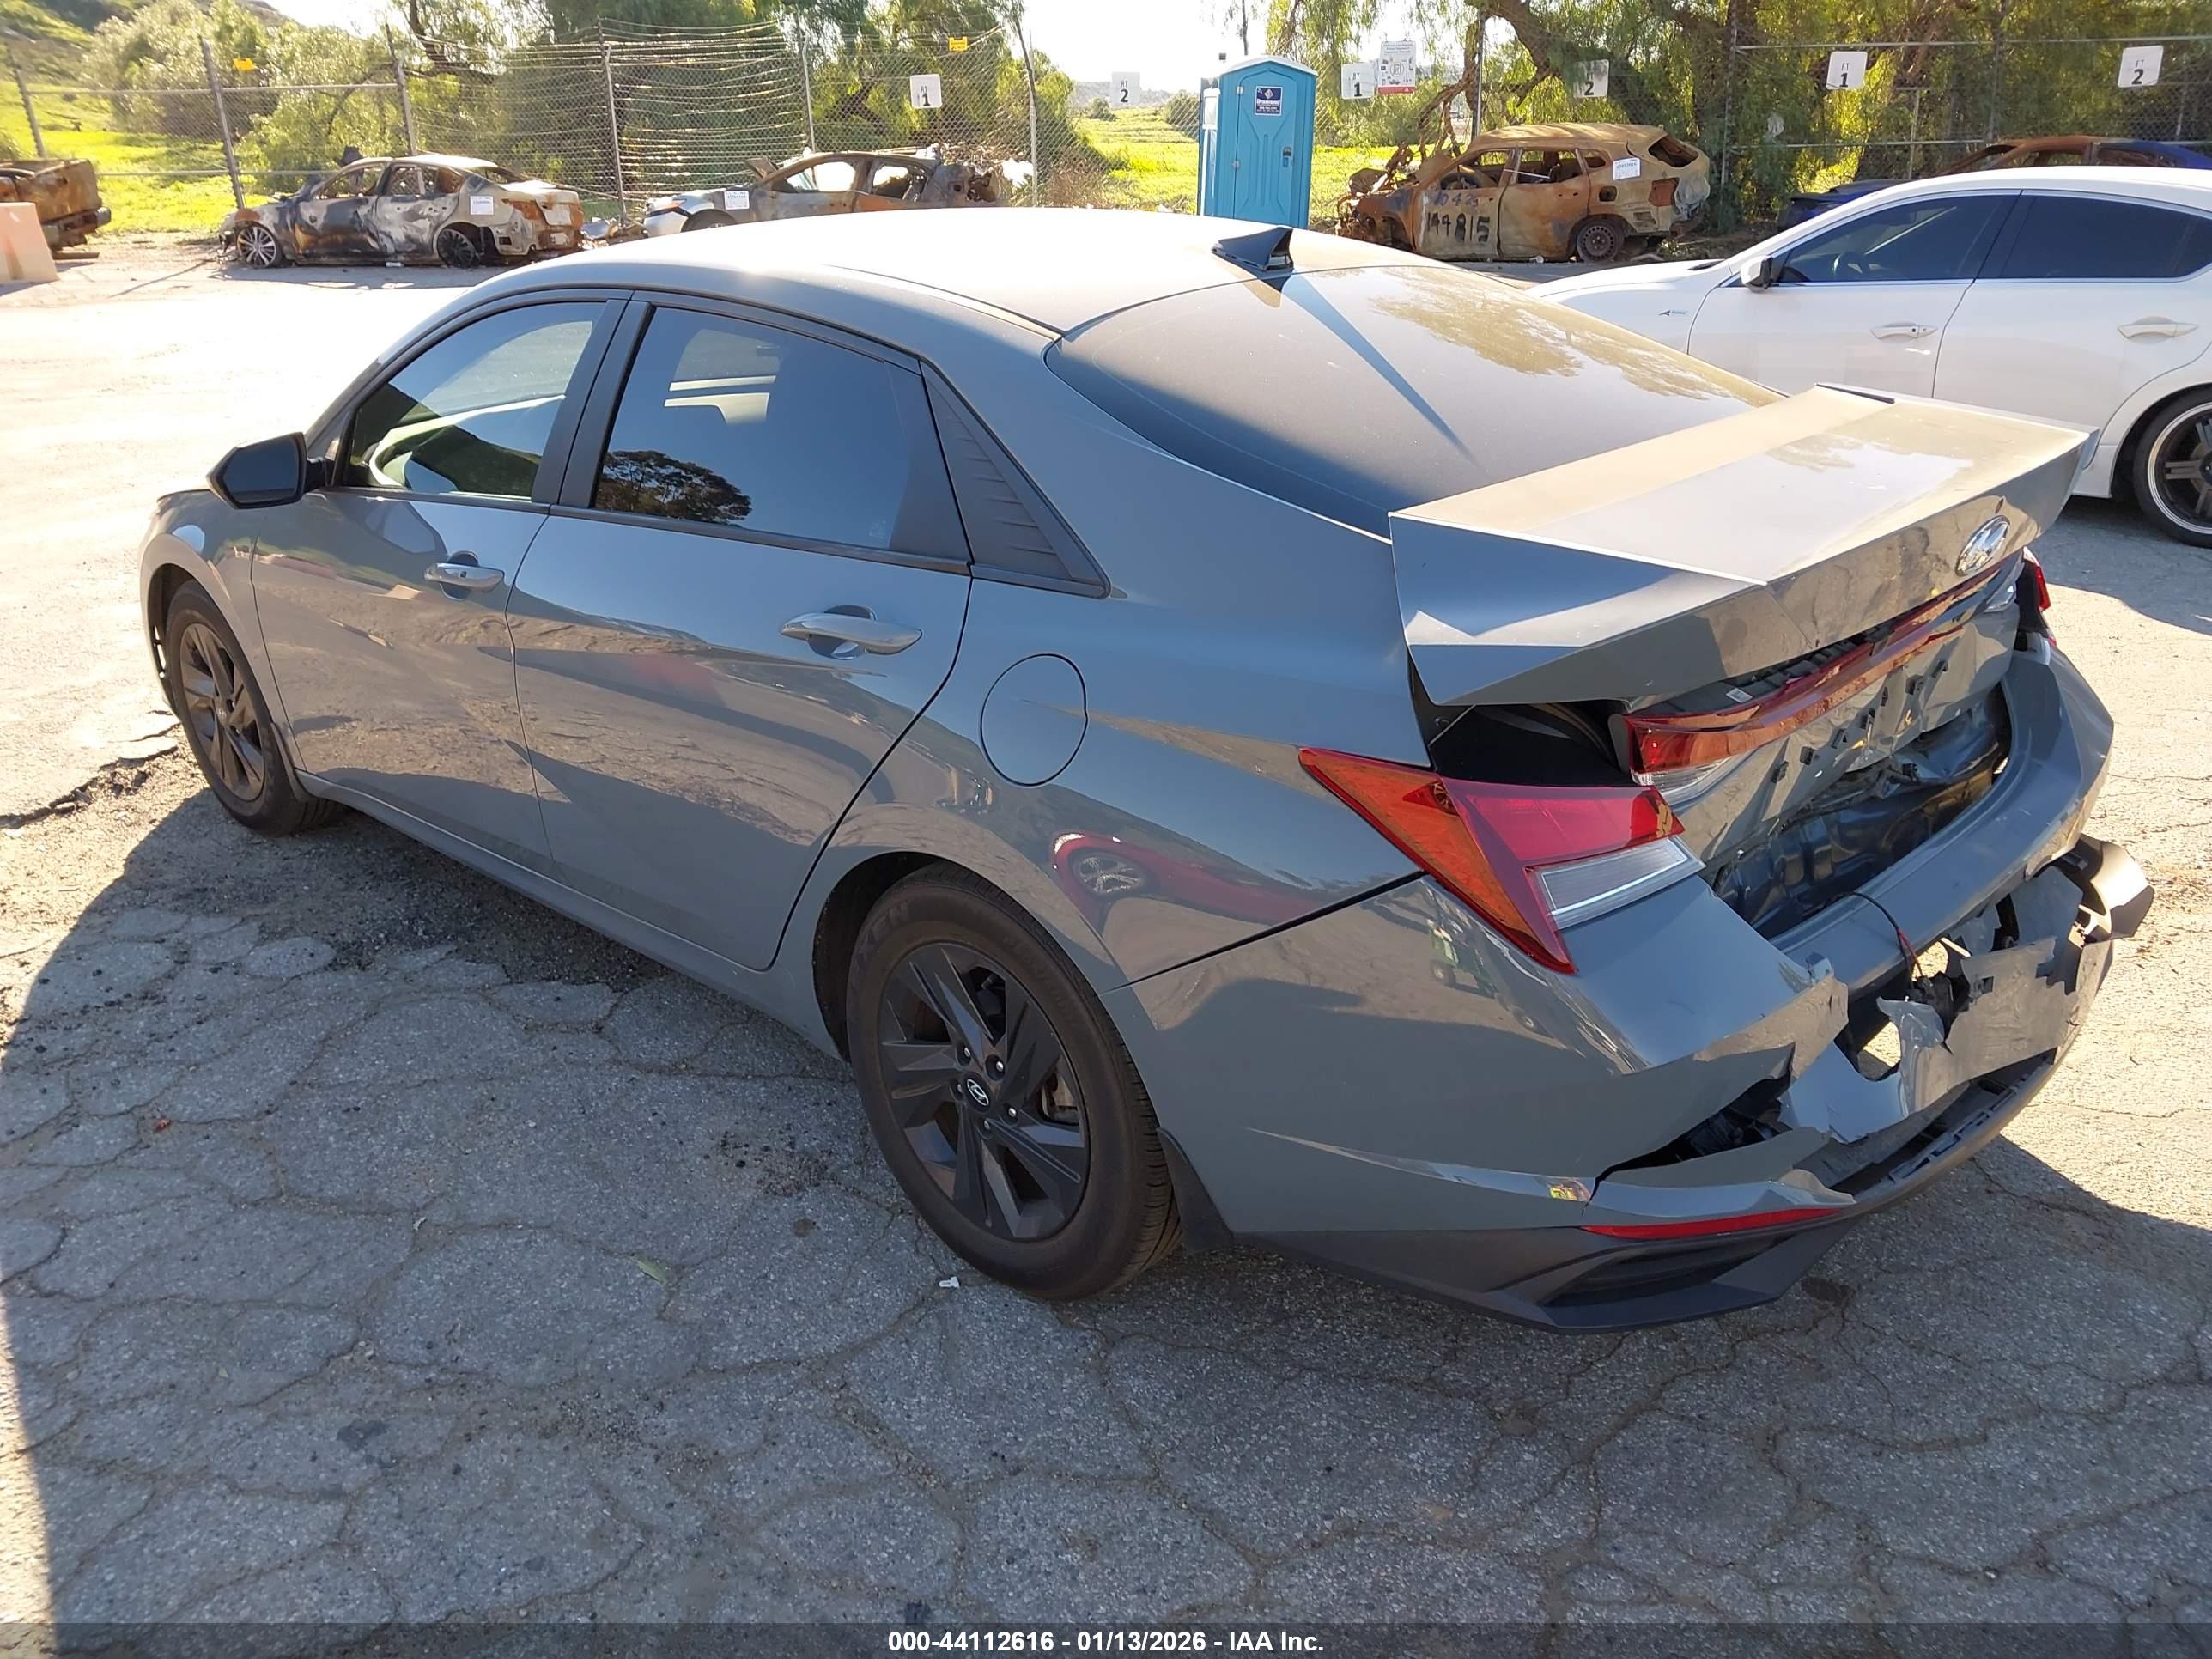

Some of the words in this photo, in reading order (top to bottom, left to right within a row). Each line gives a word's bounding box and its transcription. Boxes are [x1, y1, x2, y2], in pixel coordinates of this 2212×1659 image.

[1839, 72, 1849, 88] 1
[2131, 69, 2144, 85] 2
[1120, 88, 1129, 103] 2
[1354, 82, 1363, 97] 1
[1584, 81, 1595, 96] 2
[922, 92, 931, 106] 1
